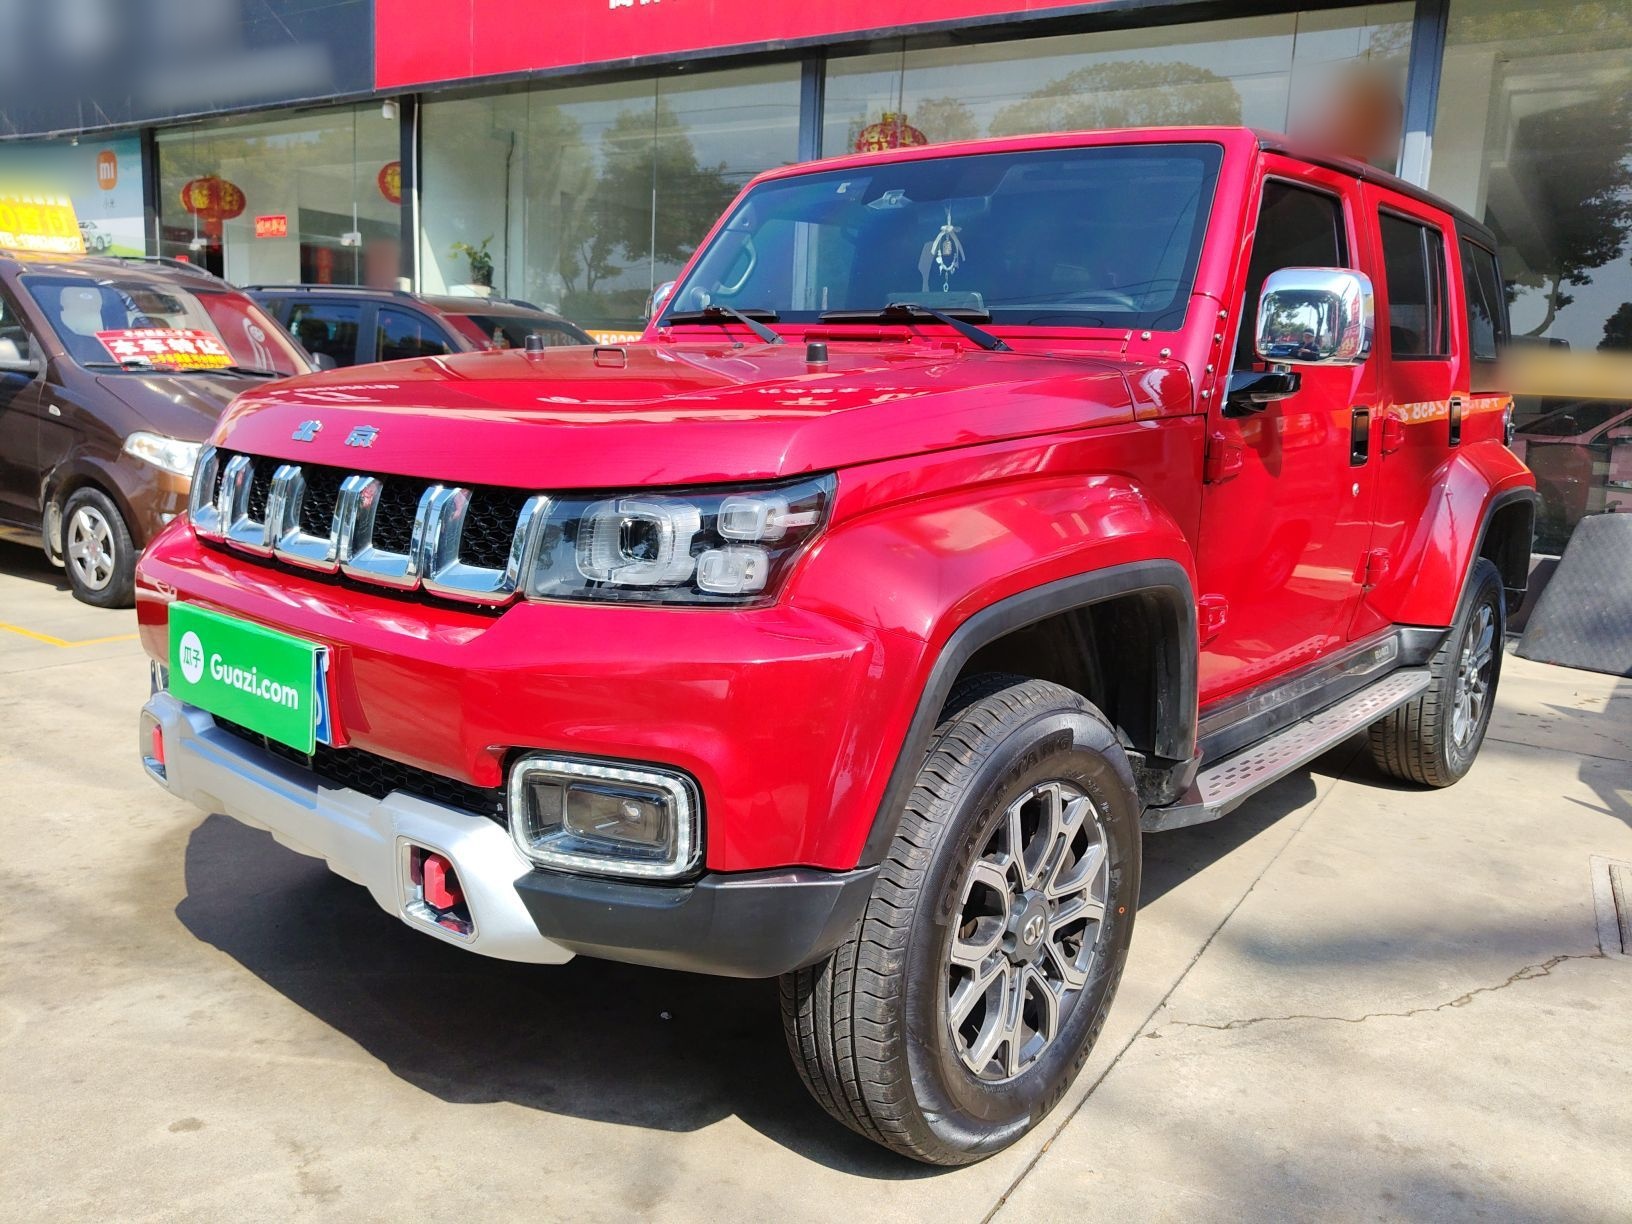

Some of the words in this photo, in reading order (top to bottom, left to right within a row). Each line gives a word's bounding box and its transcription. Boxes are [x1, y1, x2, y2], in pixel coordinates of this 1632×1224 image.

[108, 338, 226, 355] 本车转让
[183, 646, 201, 669] 瓜子
[210, 653, 299, 710] Guazi.com
